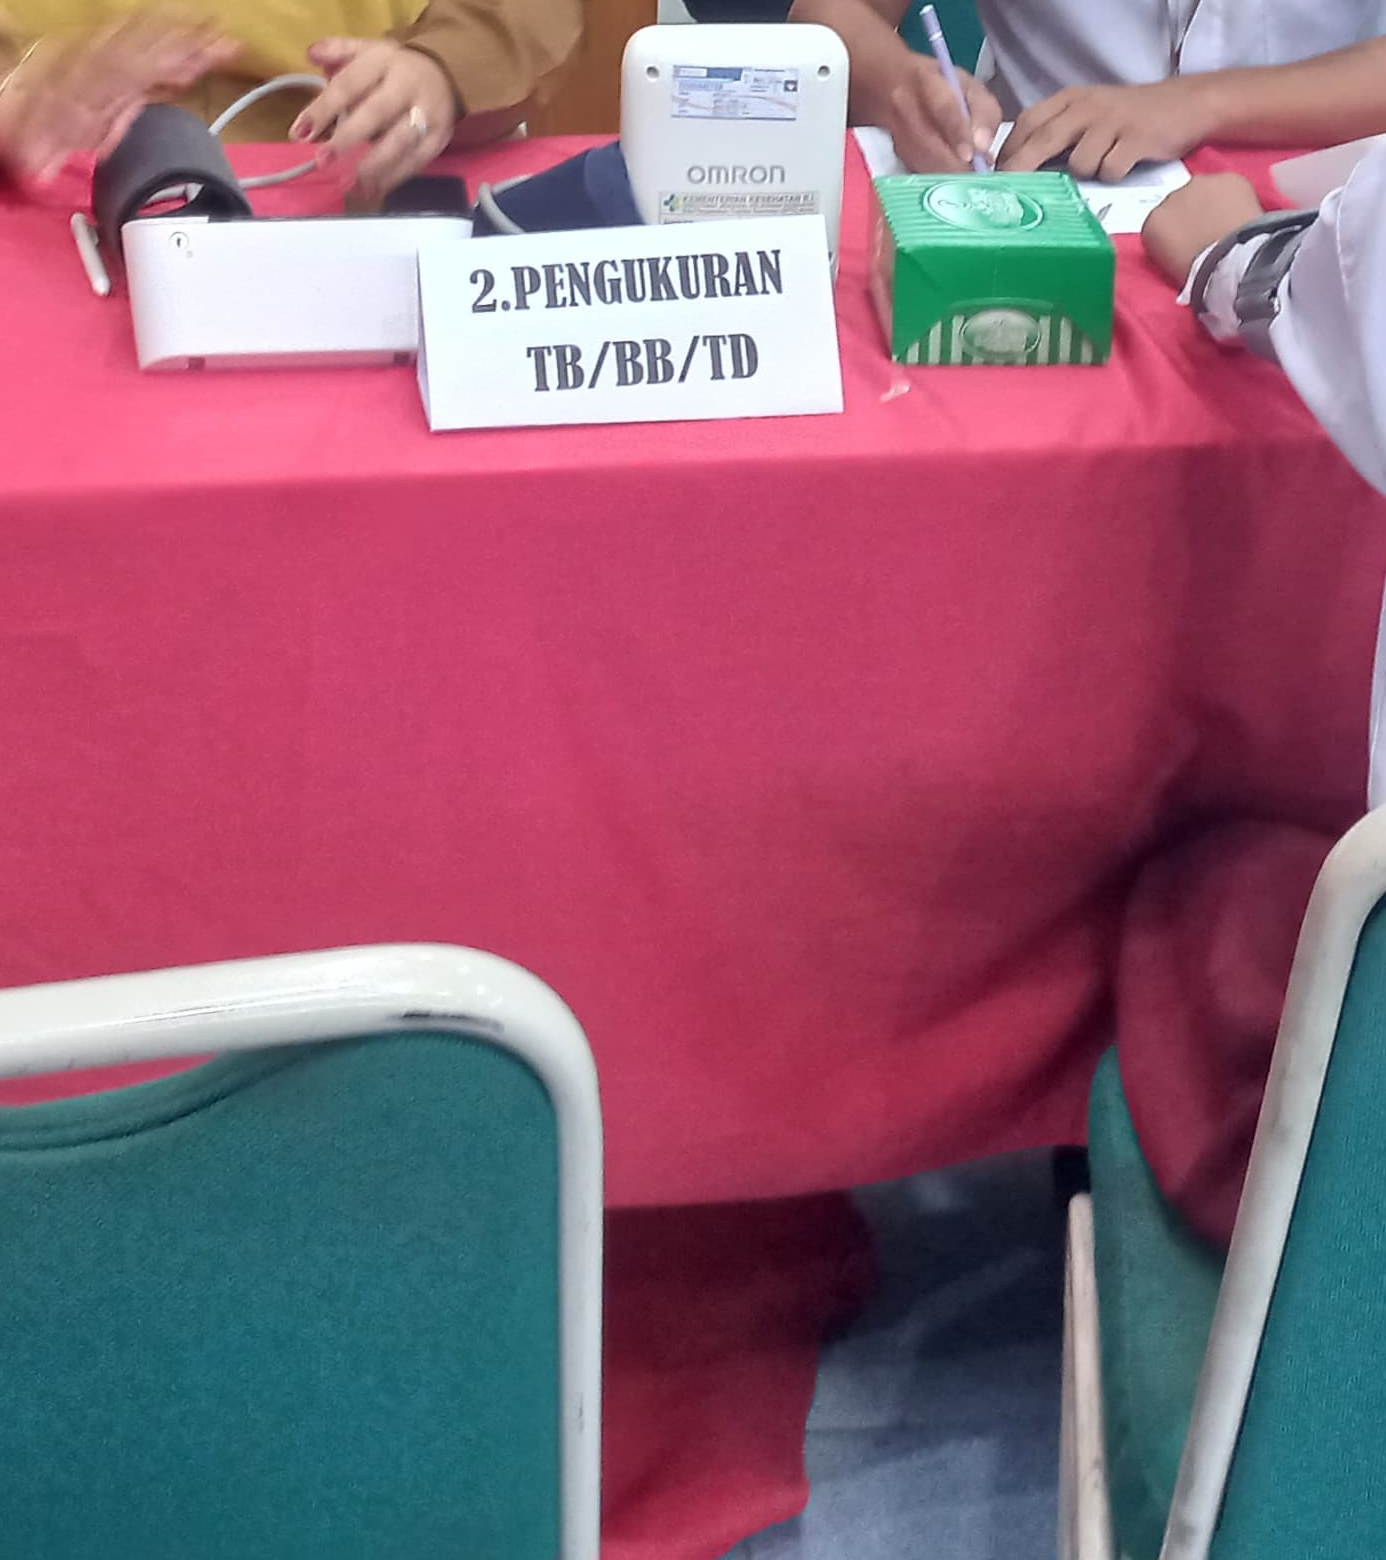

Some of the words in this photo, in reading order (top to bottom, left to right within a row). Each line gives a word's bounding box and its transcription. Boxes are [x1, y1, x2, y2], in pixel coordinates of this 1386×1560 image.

[687, 165, 786, 185] OMRON
[469, 249, 783, 313] 2.PENGUKURAN
[527, 333, 759, 392] TB/BB/TD
